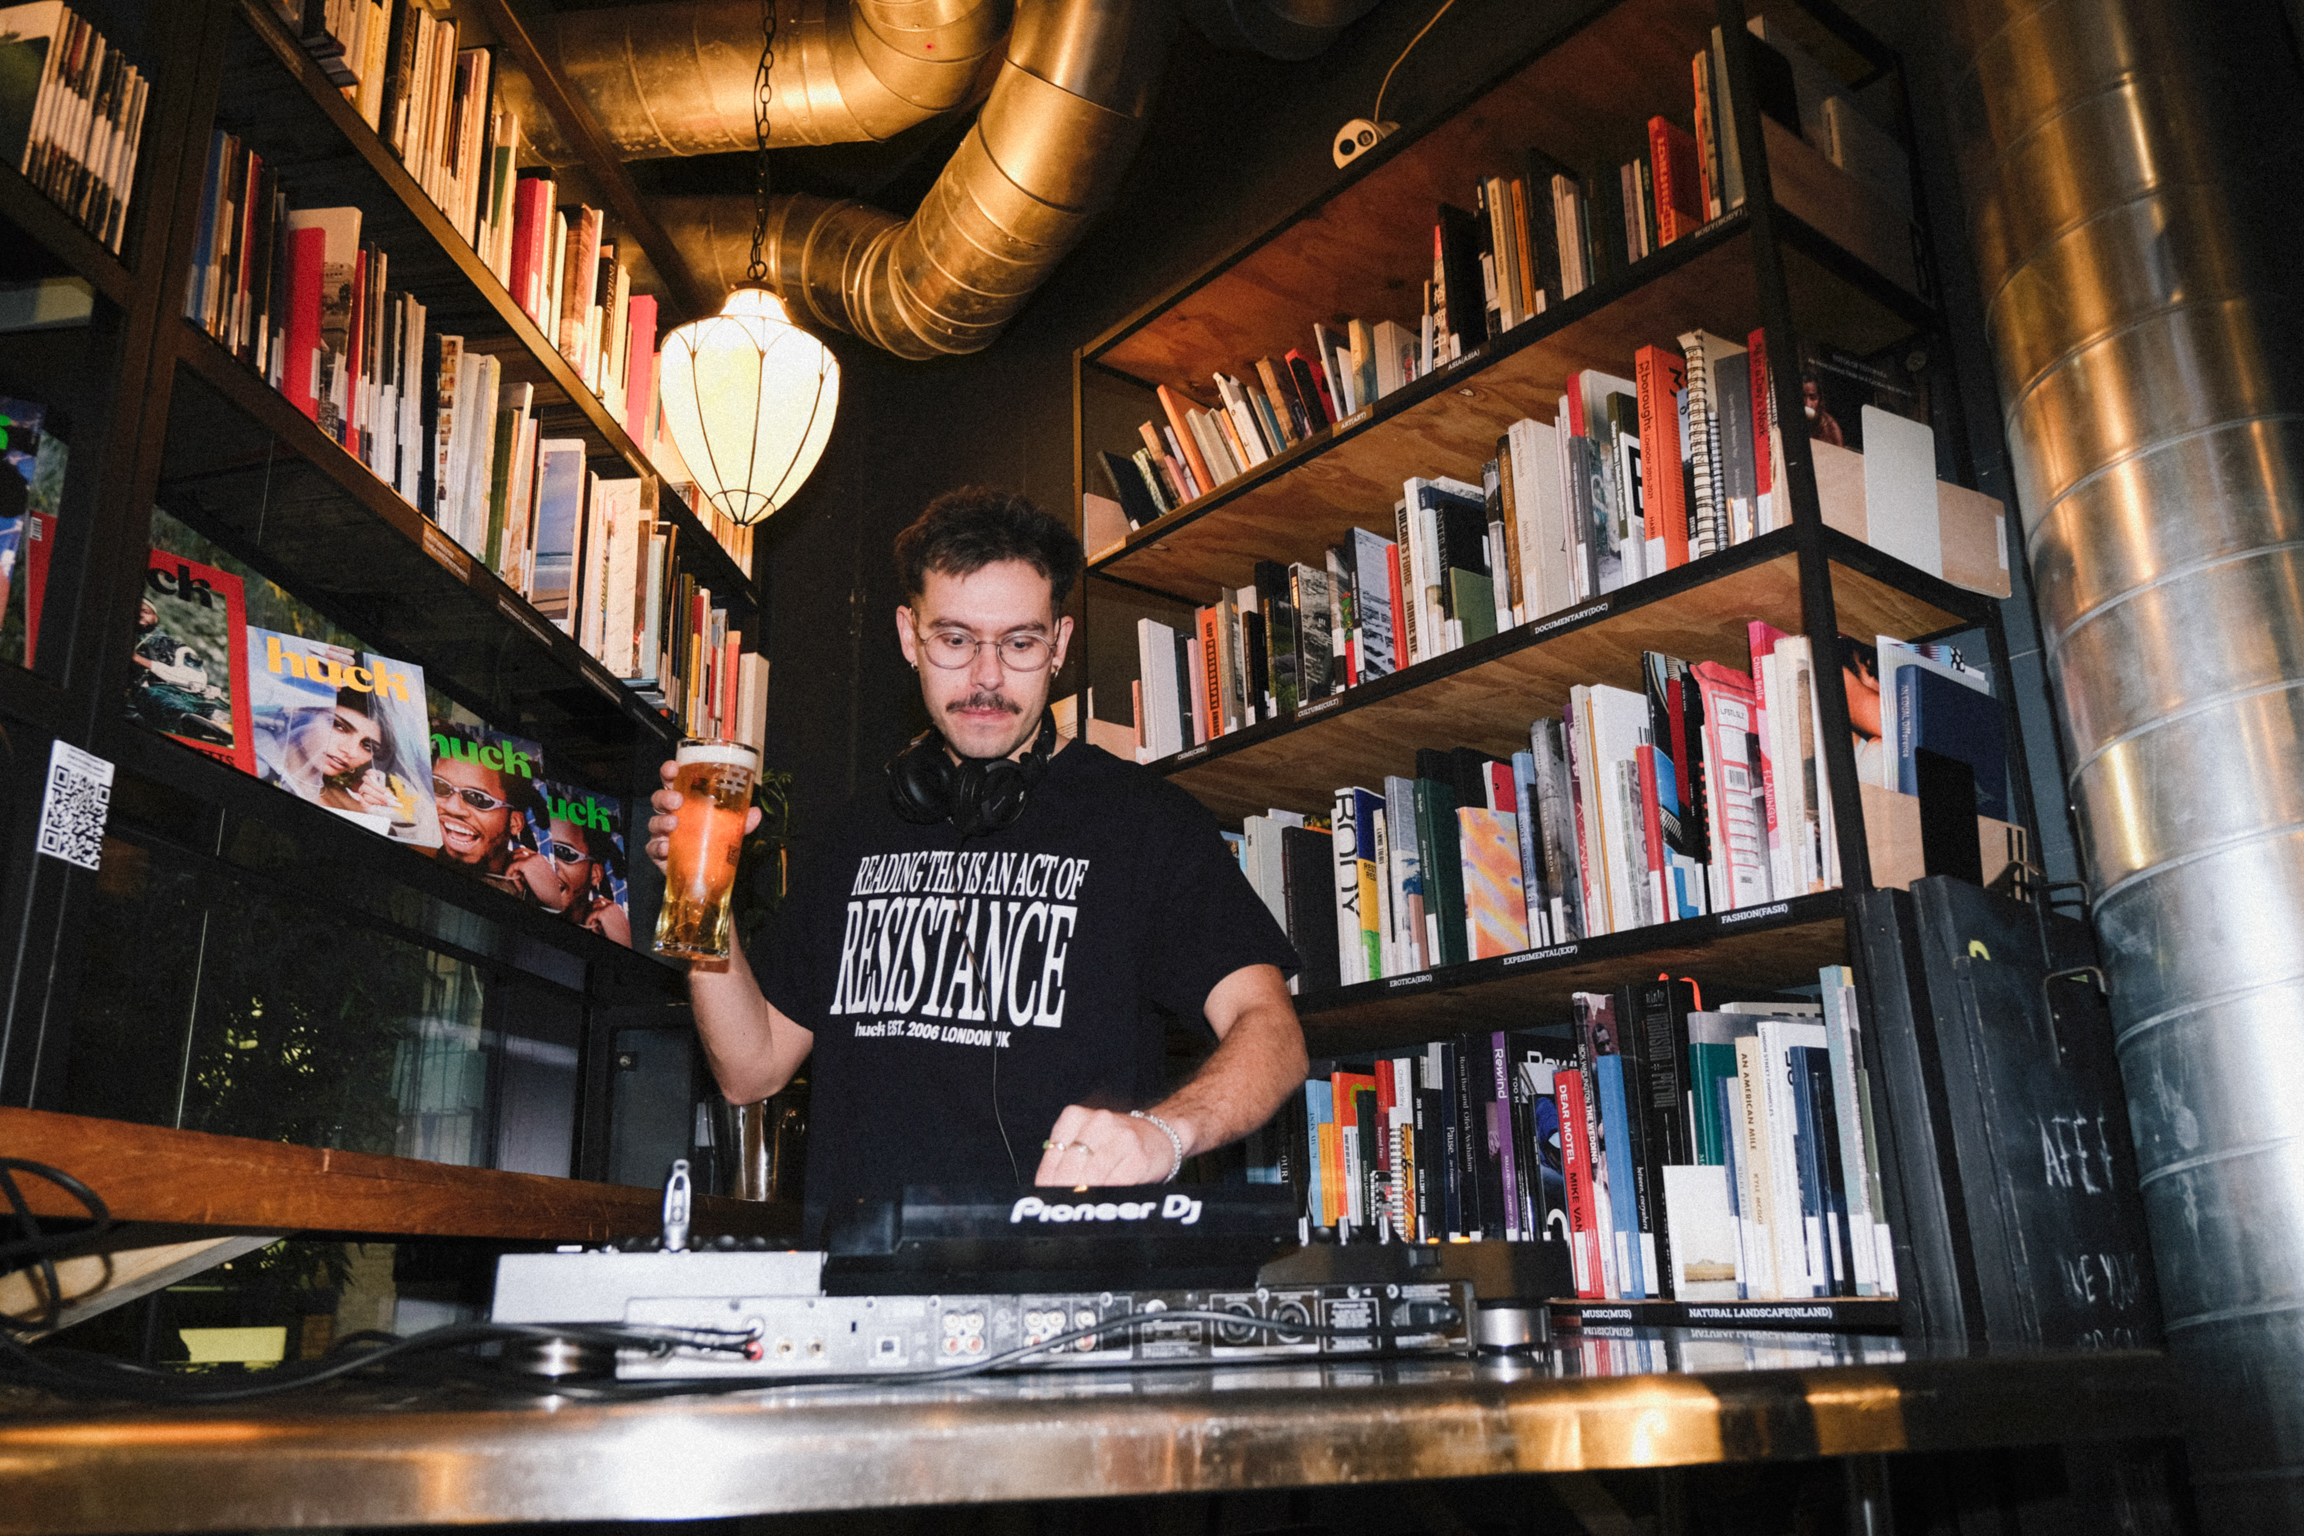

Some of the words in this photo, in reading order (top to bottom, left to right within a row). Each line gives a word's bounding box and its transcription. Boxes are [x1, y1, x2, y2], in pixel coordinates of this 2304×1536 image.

[1639, 374, 1653, 432] boroughs
[1758, 408, 1768, 438] Work
[1644, 434, 1652, 464] LONDON
[1398, 507, 1409, 554] VULCAN'S
[1402, 557, 1412, 586] FORGE
[1534, 602, 1609, 635] DOCUMENTARY(DOC)
[266, 636, 409, 702] huck
[1752, 656, 1762, 678] Chloe
[1754, 679, 1763, 701] Sells
[1298, 698, 1339, 717] CULTURE(CULT)
[1902, 721, 1911, 758] Difference
[547, 795, 611, 833] uck
[851, 851, 927, 896] READING
[923, 850, 967, 893] THIS
[964, 852, 986, 895] IS
[984, 852, 1017, 896] AN
[1011, 853, 1060, 898] ACT
[1055, 858, 1090, 901] OF
[1721, 902, 1789, 924] FASHION(FASH)
[829, 896, 1078, 1028] RESISTANCE
[1503, 945, 1578, 965] EXPERIMENTAL(EXP)
[1389, 974, 1433, 988] EROTICA(ERO)
[855, 1021, 886, 1038] huck
[887, 1020, 905, 1037] EST.
[906, 1021, 940, 1041] 2006
[940, 1025, 992, 1047] LONDON
[1578, 1043, 1586, 1060] NICK
[1741, 1052, 1749, 1069] AN
[1494, 1048, 1508, 1099] Rewind
[1580, 1060, 1591, 1104] WAPLINGTON
[1558, 1084, 1570, 1119] DEAR
[1743, 1071, 1754, 1123] AMERICAN
[1765, 1080, 1774, 1117] CHRONICLES
[1585, 1104, 1594, 1122] THE
[1446, 1126, 1455, 1155] Pause.
[1465, 1130, 1474, 1173] Avshalom
[1563, 1121, 1576, 1165] MOTEL
[1587, 1122, 1599, 1164] WEDDING
[1747, 1126, 1758, 1152] MILE
[1569, 1172, 1580, 1203] MIKE
[1011, 1195, 1157, 1225] Pioneer
[1573, 1206, 1583, 1233] VAN
[1638, 1195, 1649, 1231] everywhere
[1582, 1309, 1632, 1320] MUSIC(MUS)
[1689, 1308, 1732, 1319] NATURAL
[1733, 1307, 1832, 1320] LANDSCAPE(NLAND)
